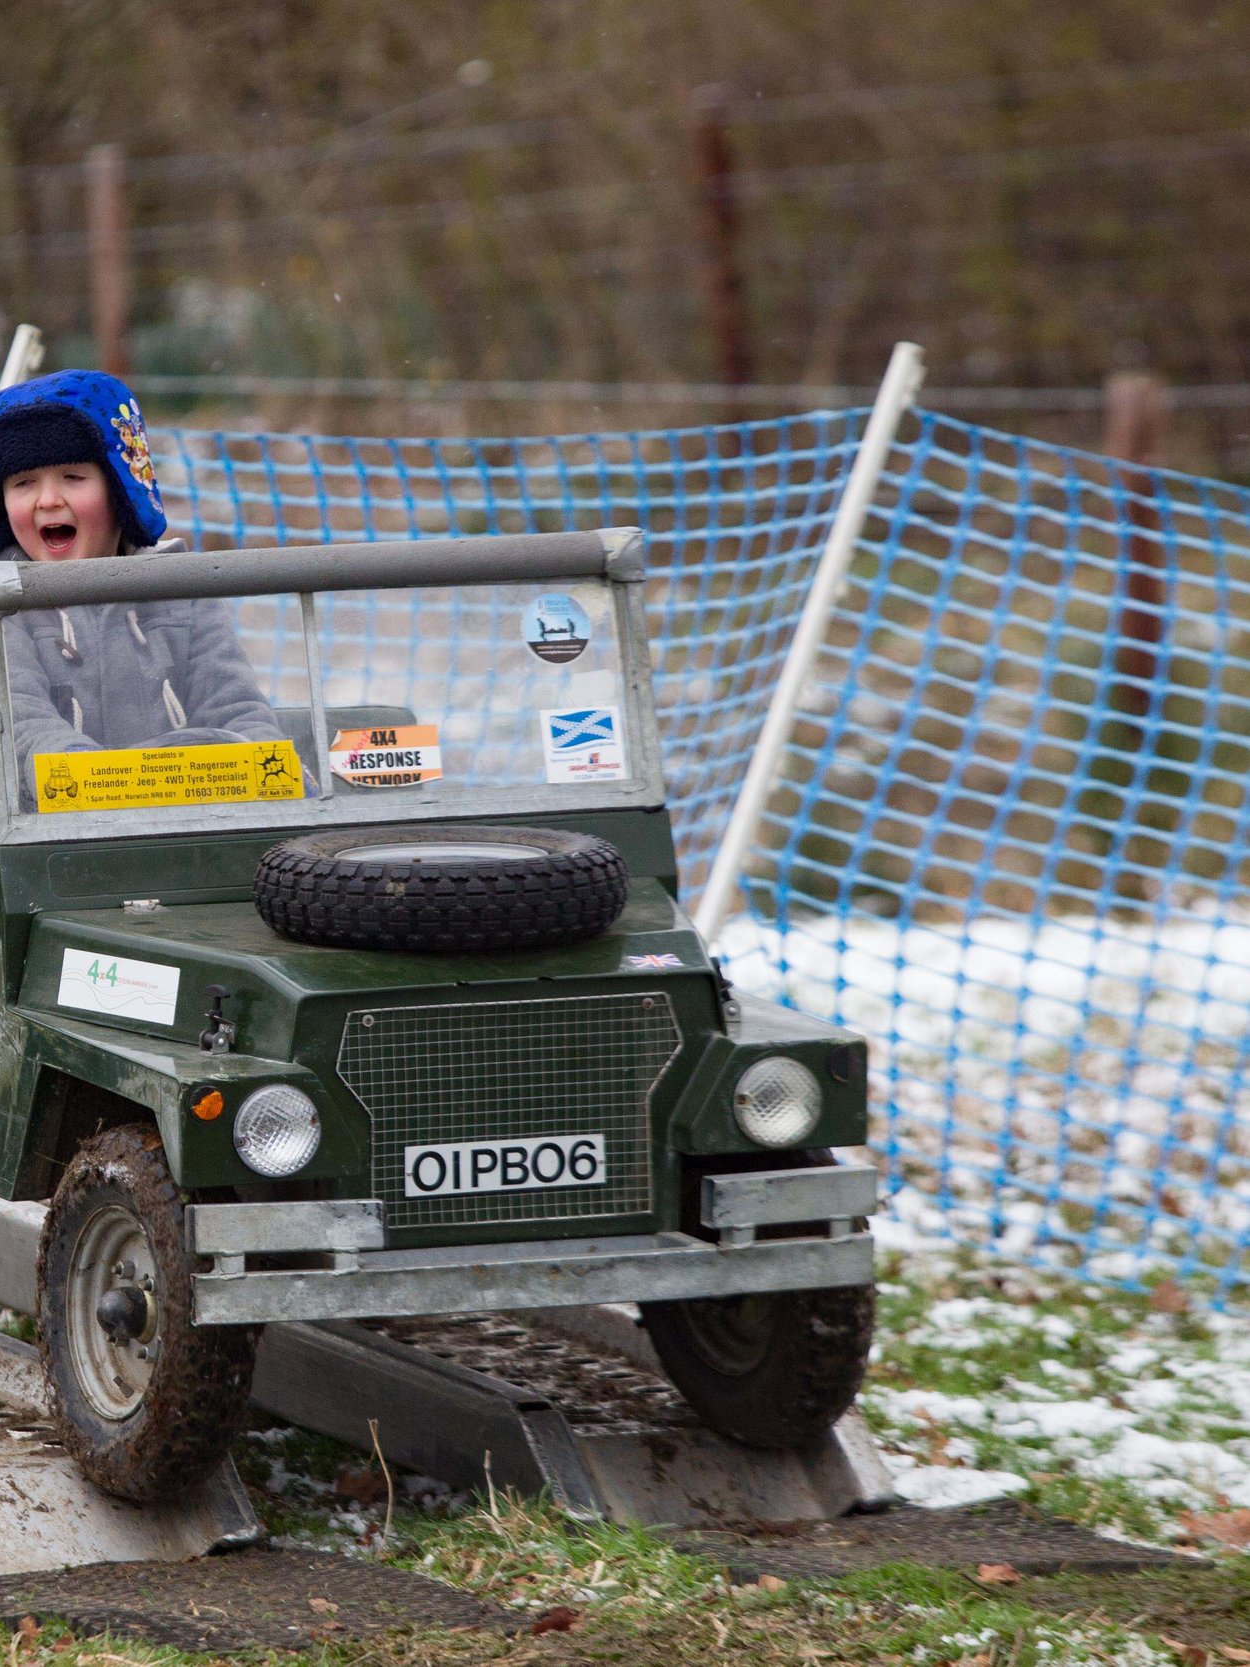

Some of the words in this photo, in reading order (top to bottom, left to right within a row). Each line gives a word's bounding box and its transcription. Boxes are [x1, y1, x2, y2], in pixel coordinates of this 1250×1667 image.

[370, 730, 397, 746] 4X4
[142, 752, 176, 760] Specialists
[350, 750, 421, 769] RESPONSE
[91, 766, 133, 776] Landrover
[141, 764, 181, 773] Discovery
[190, 761, 238, 771] Rangerover
[84, 779, 128, 789] Freelander
[137, 777, 156, 786] Jeep
[165, 775, 184, 784] 4WD
[187, 774, 204, 784] Tyre
[207, 773, 248, 783] Specialist
[185, 787, 212, 797] 01603
[216, 785, 247, 796] 787064
